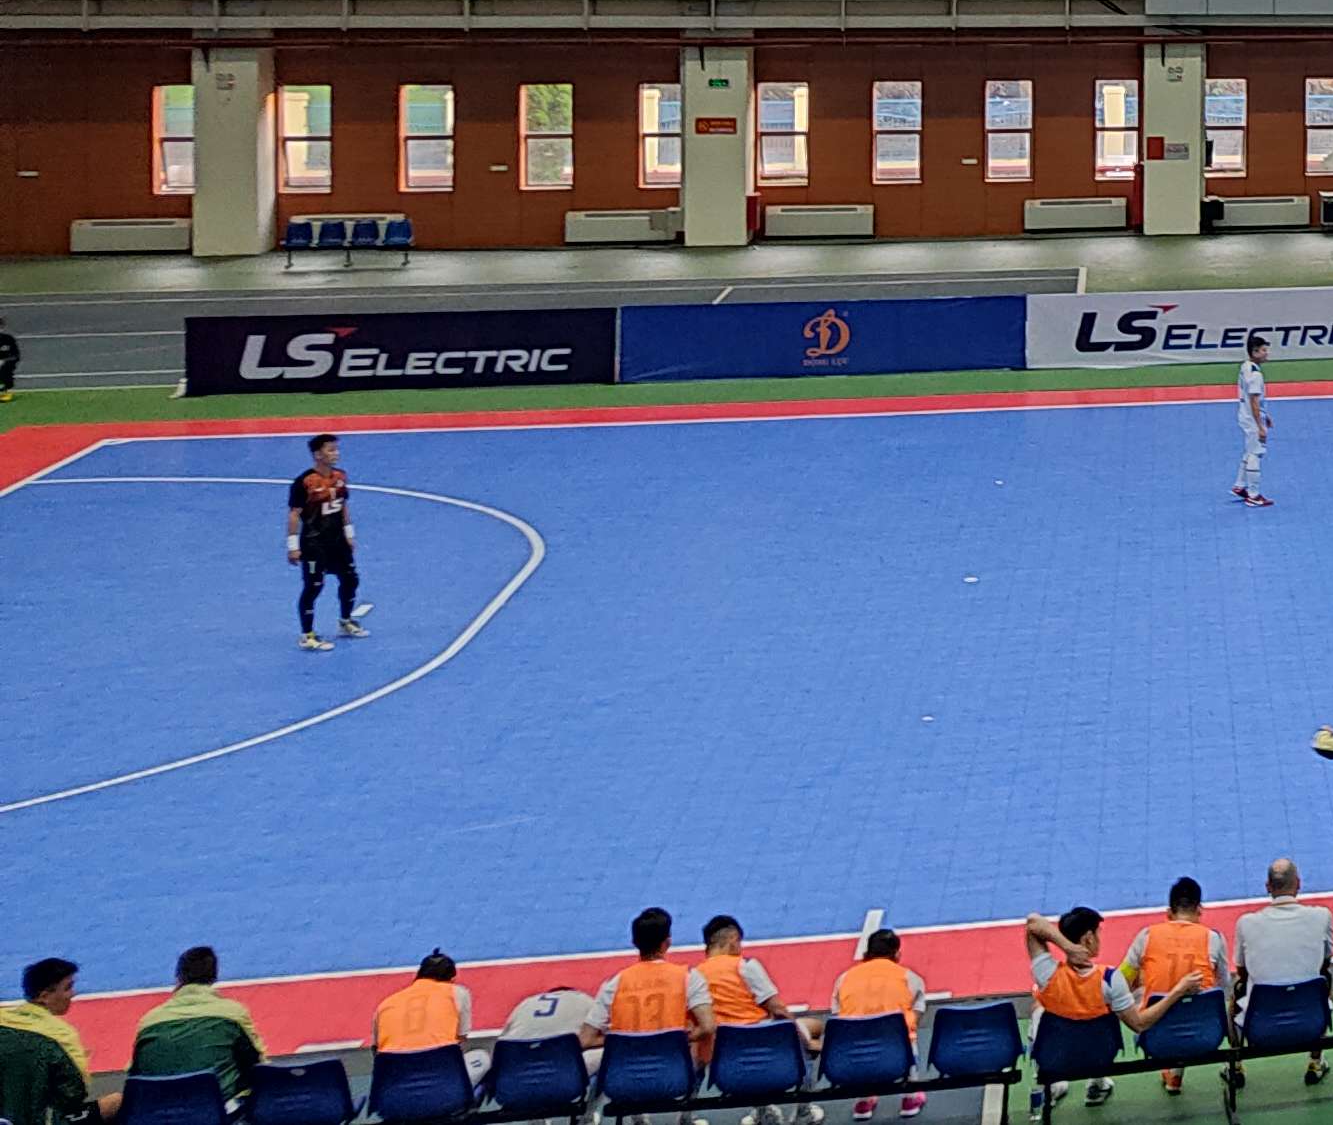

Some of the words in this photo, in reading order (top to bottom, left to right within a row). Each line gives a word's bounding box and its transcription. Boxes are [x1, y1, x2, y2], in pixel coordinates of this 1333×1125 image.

[1075, 310, 1159, 353] LS
[239, 332, 337, 380] LS
[337, 347, 573, 378] ELECTRIC
[321, 497, 345, 515] LS
